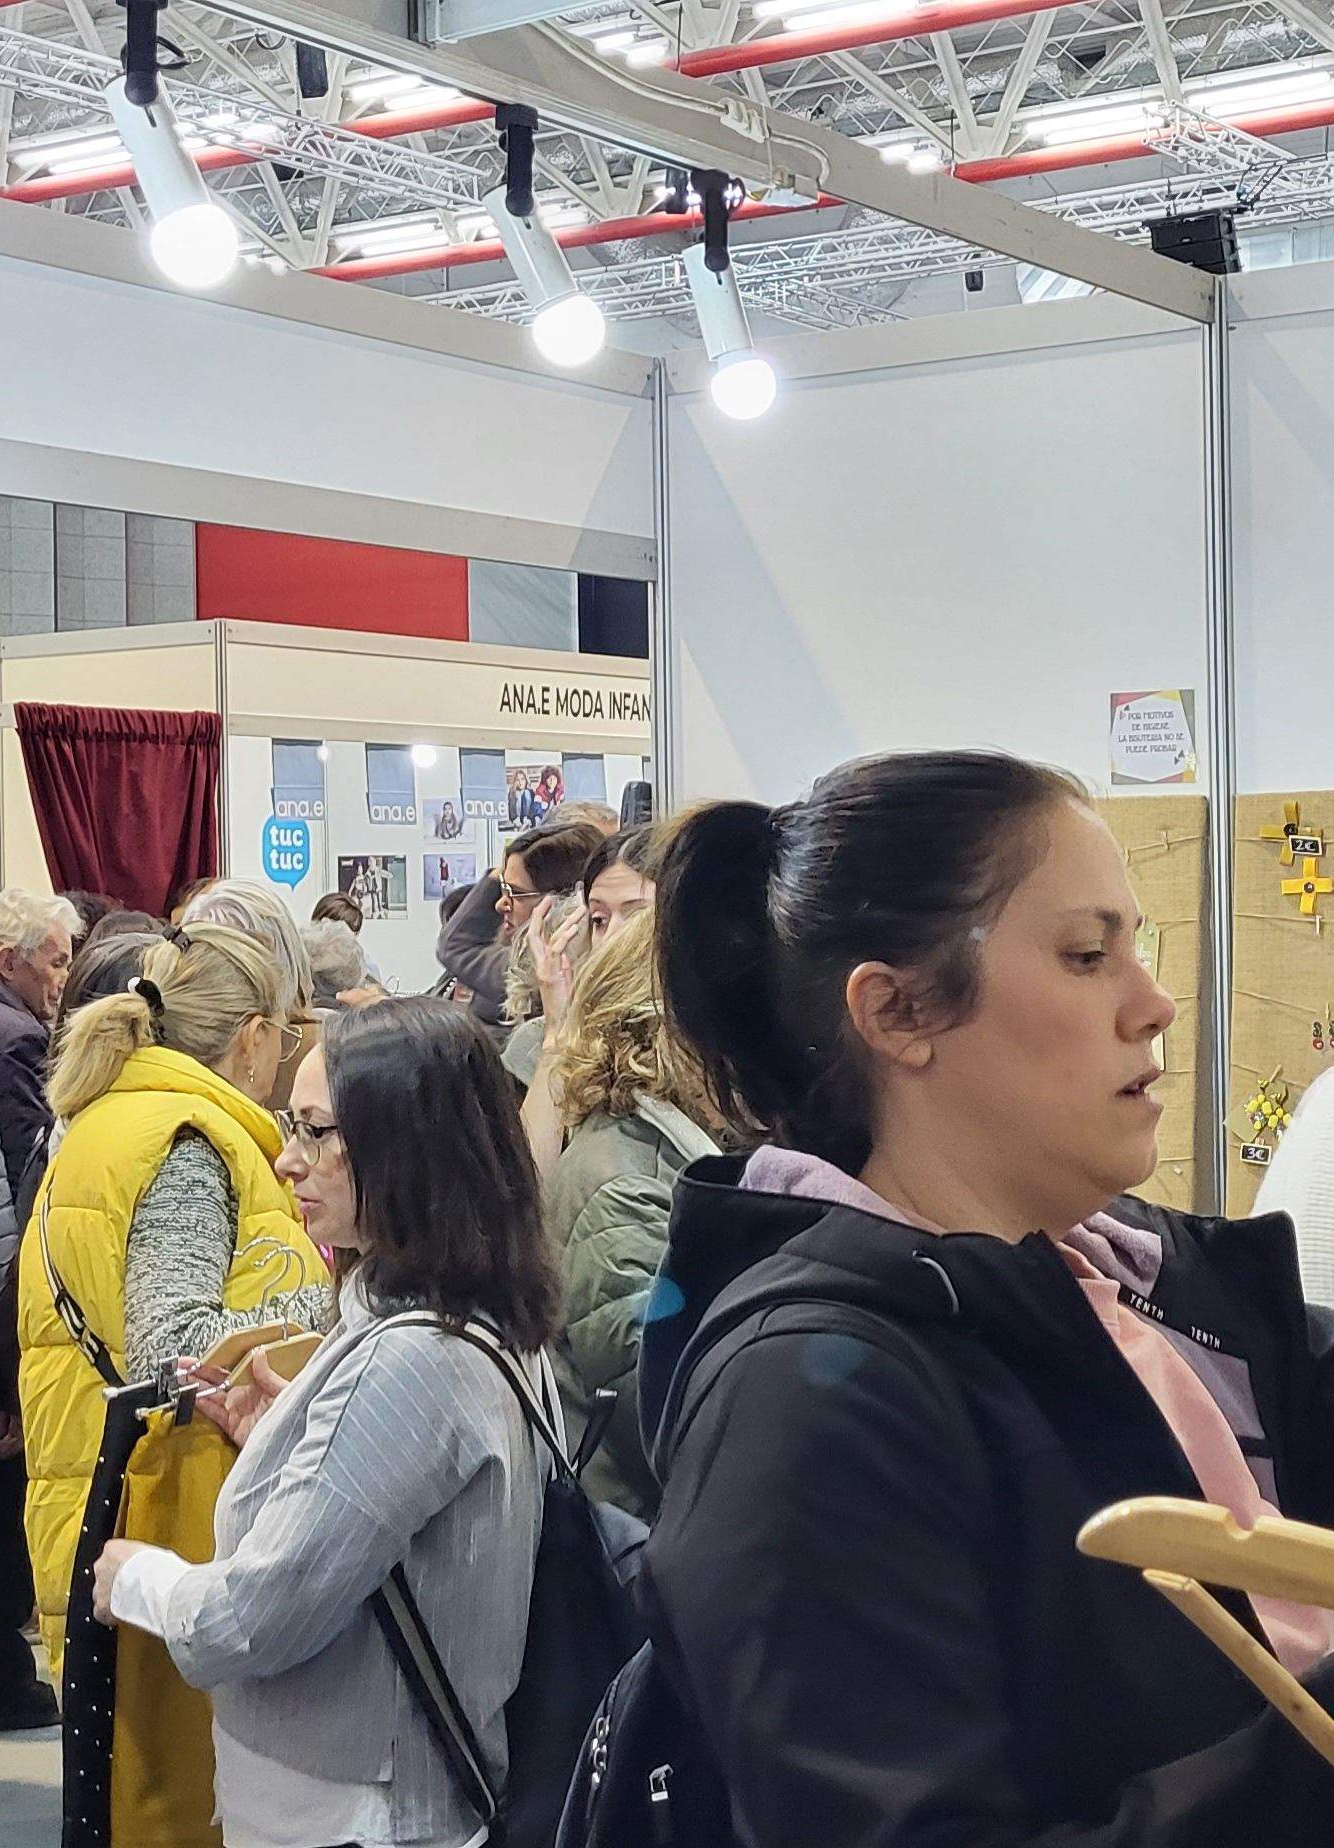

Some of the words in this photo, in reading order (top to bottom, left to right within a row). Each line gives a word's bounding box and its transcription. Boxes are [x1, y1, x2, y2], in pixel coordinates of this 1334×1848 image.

[499, 682, 551, 716] ANA.E
[555, 687, 605, 719] MODA
[276, 799, 325, 818] ana.e
[370, 803, 416, 822] ana.e
[464, 799, 509, 817] ana.e
[269, 825, 305, 847] tuc
[269, 849, 305, 871] tuc
